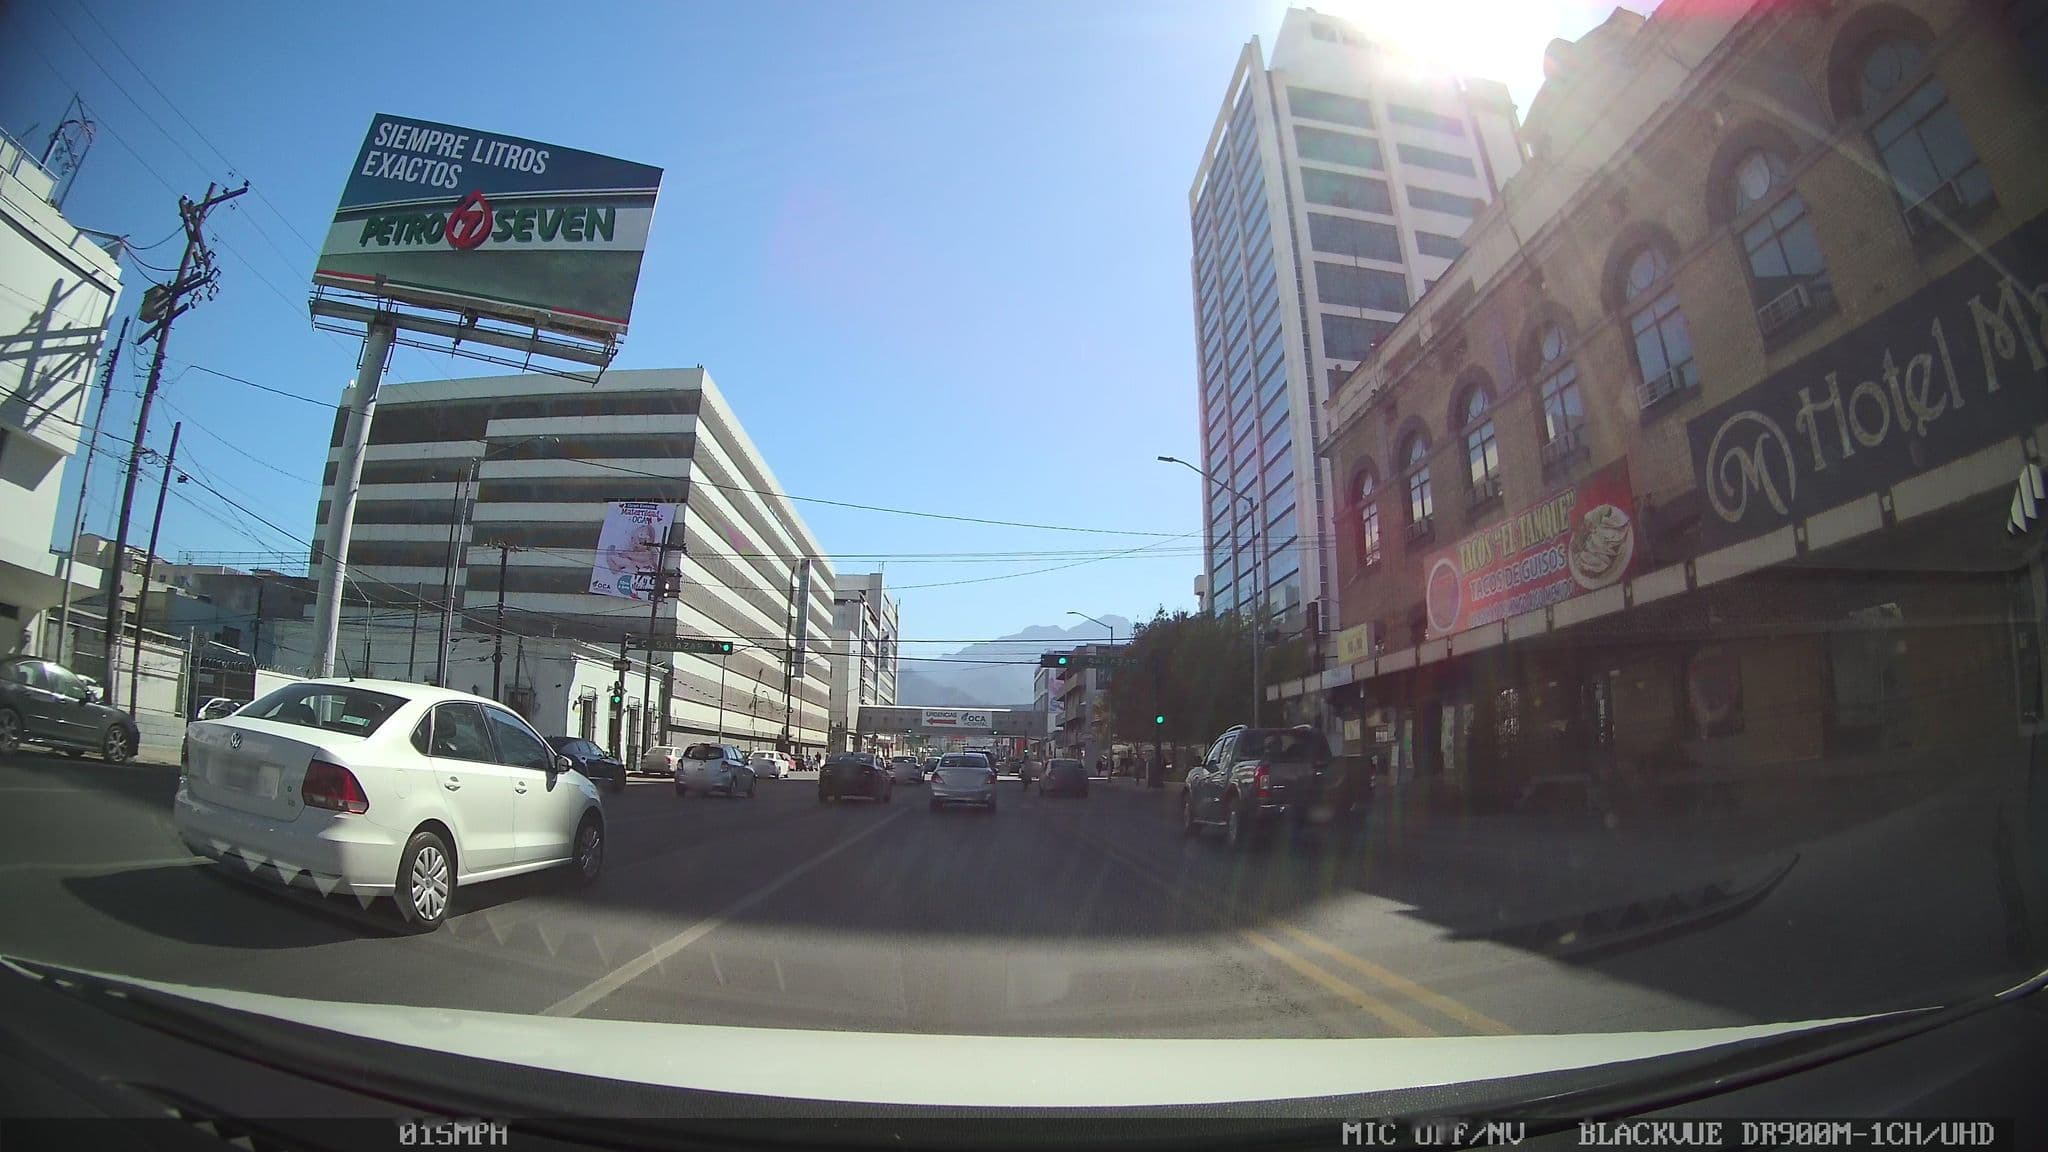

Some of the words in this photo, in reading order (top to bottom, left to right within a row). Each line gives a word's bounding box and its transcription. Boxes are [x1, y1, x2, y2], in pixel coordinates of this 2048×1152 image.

[361, 150, 463, 189] EXACTOS
[374, 122, 470, 160] SIEMPRE
[471, 138, 550, 175] LITROS
[360, 212, 448, 247] PETRO
[491, 206, 616, 243] SEVEN
[1795, 316, 1966, 472] Hotel
[1469, 570, 1503, 600] TACOS
[1503, 561, 1522, 588] DE
[1520, 544, 1568, 582] GUISOS
